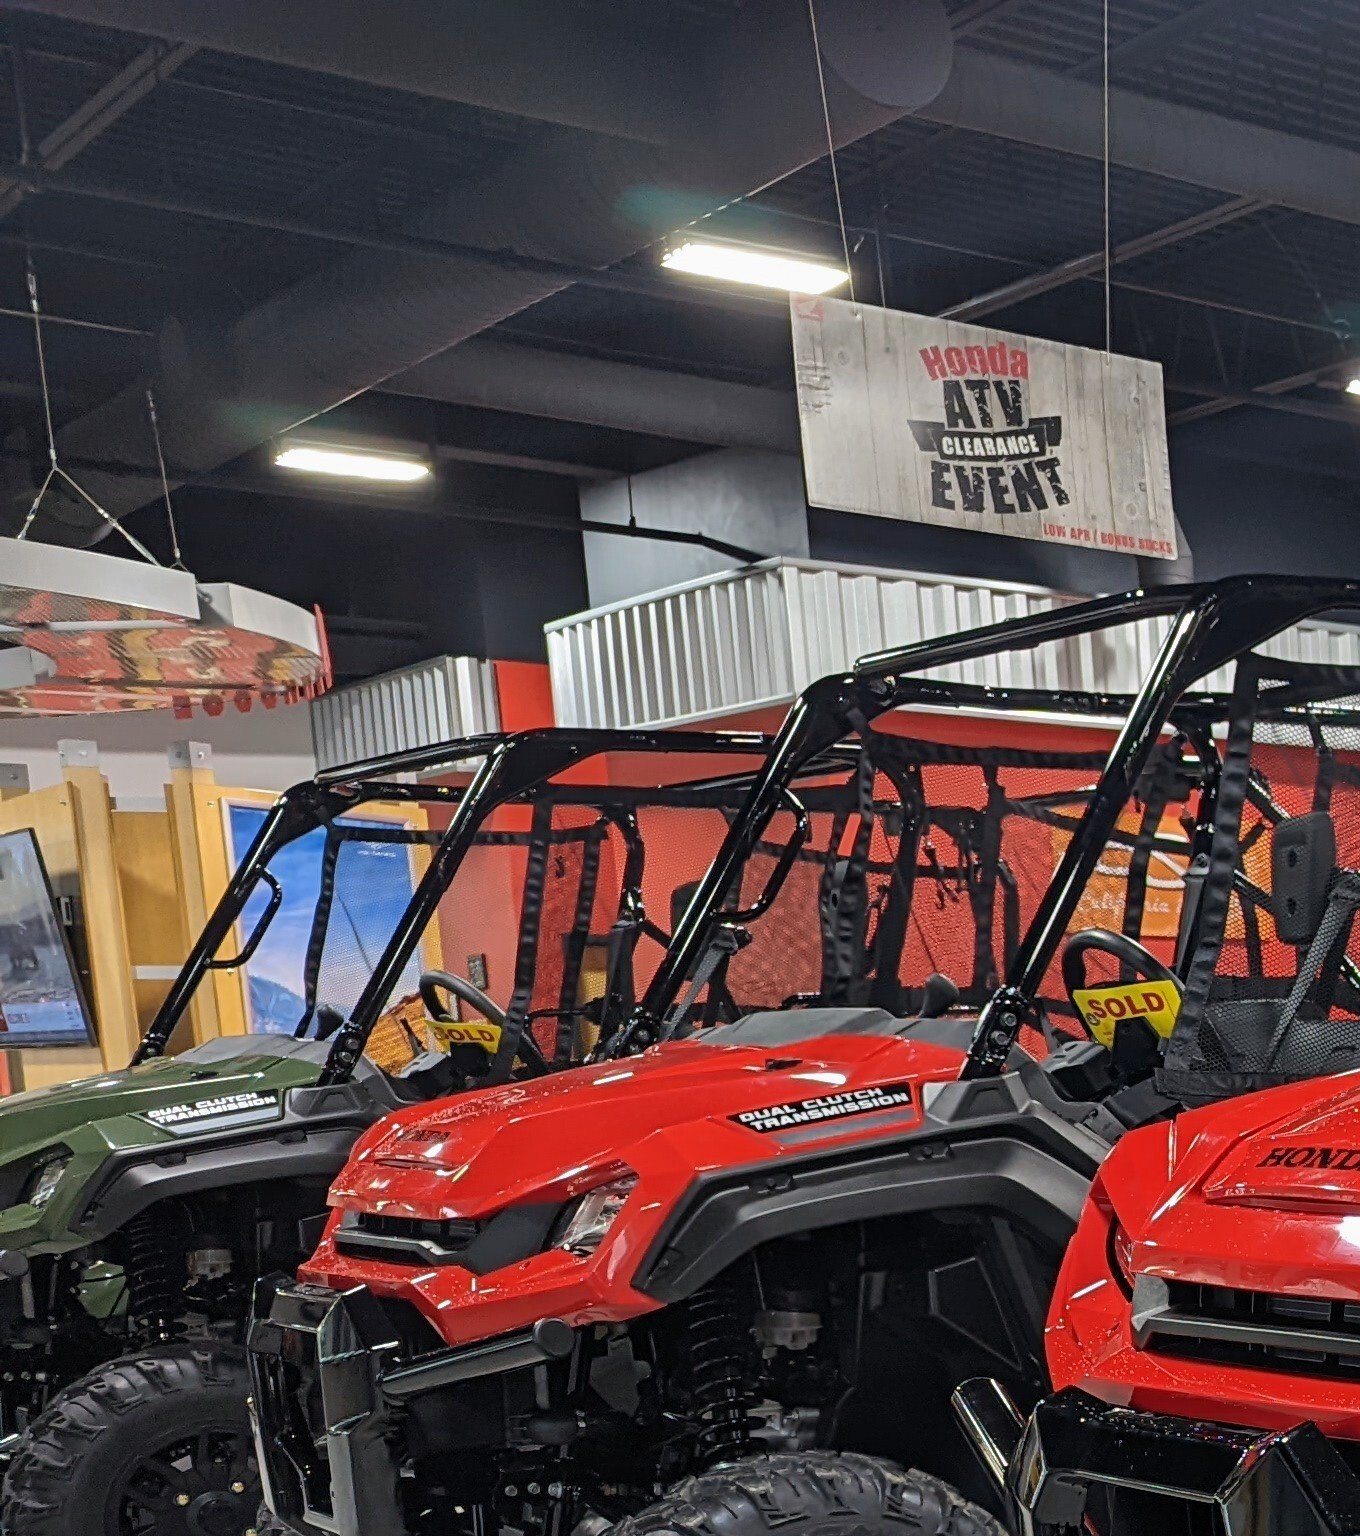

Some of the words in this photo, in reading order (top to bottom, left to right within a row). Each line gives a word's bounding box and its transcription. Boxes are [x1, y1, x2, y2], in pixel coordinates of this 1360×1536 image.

[919, 341, 1029, 381] Honda
[942, 379, 1026, 429] ATV
[942, 432, 1040, 457] CLEARANCE
[931, 457, 1070, 514] EVENT
[1043, 522, 1066, 538] LOW
[1070, 526, 1091, 541] APR
[1087, 992, 1165, 1019] SOLD
[433, 1026, 495, 1042] SOLD
[147, 1104, 192, 1118] DUAL
[195, 1092, 258, 1109] CLUTCH
[154, 1095, 277, 1124] TRANSMISSION
[738, 1105, 797, 1123] DUAL
[802, 1087, 883, 1109] CLUTCH
[750, 1092, 910, 1131] TRANSMISSION
